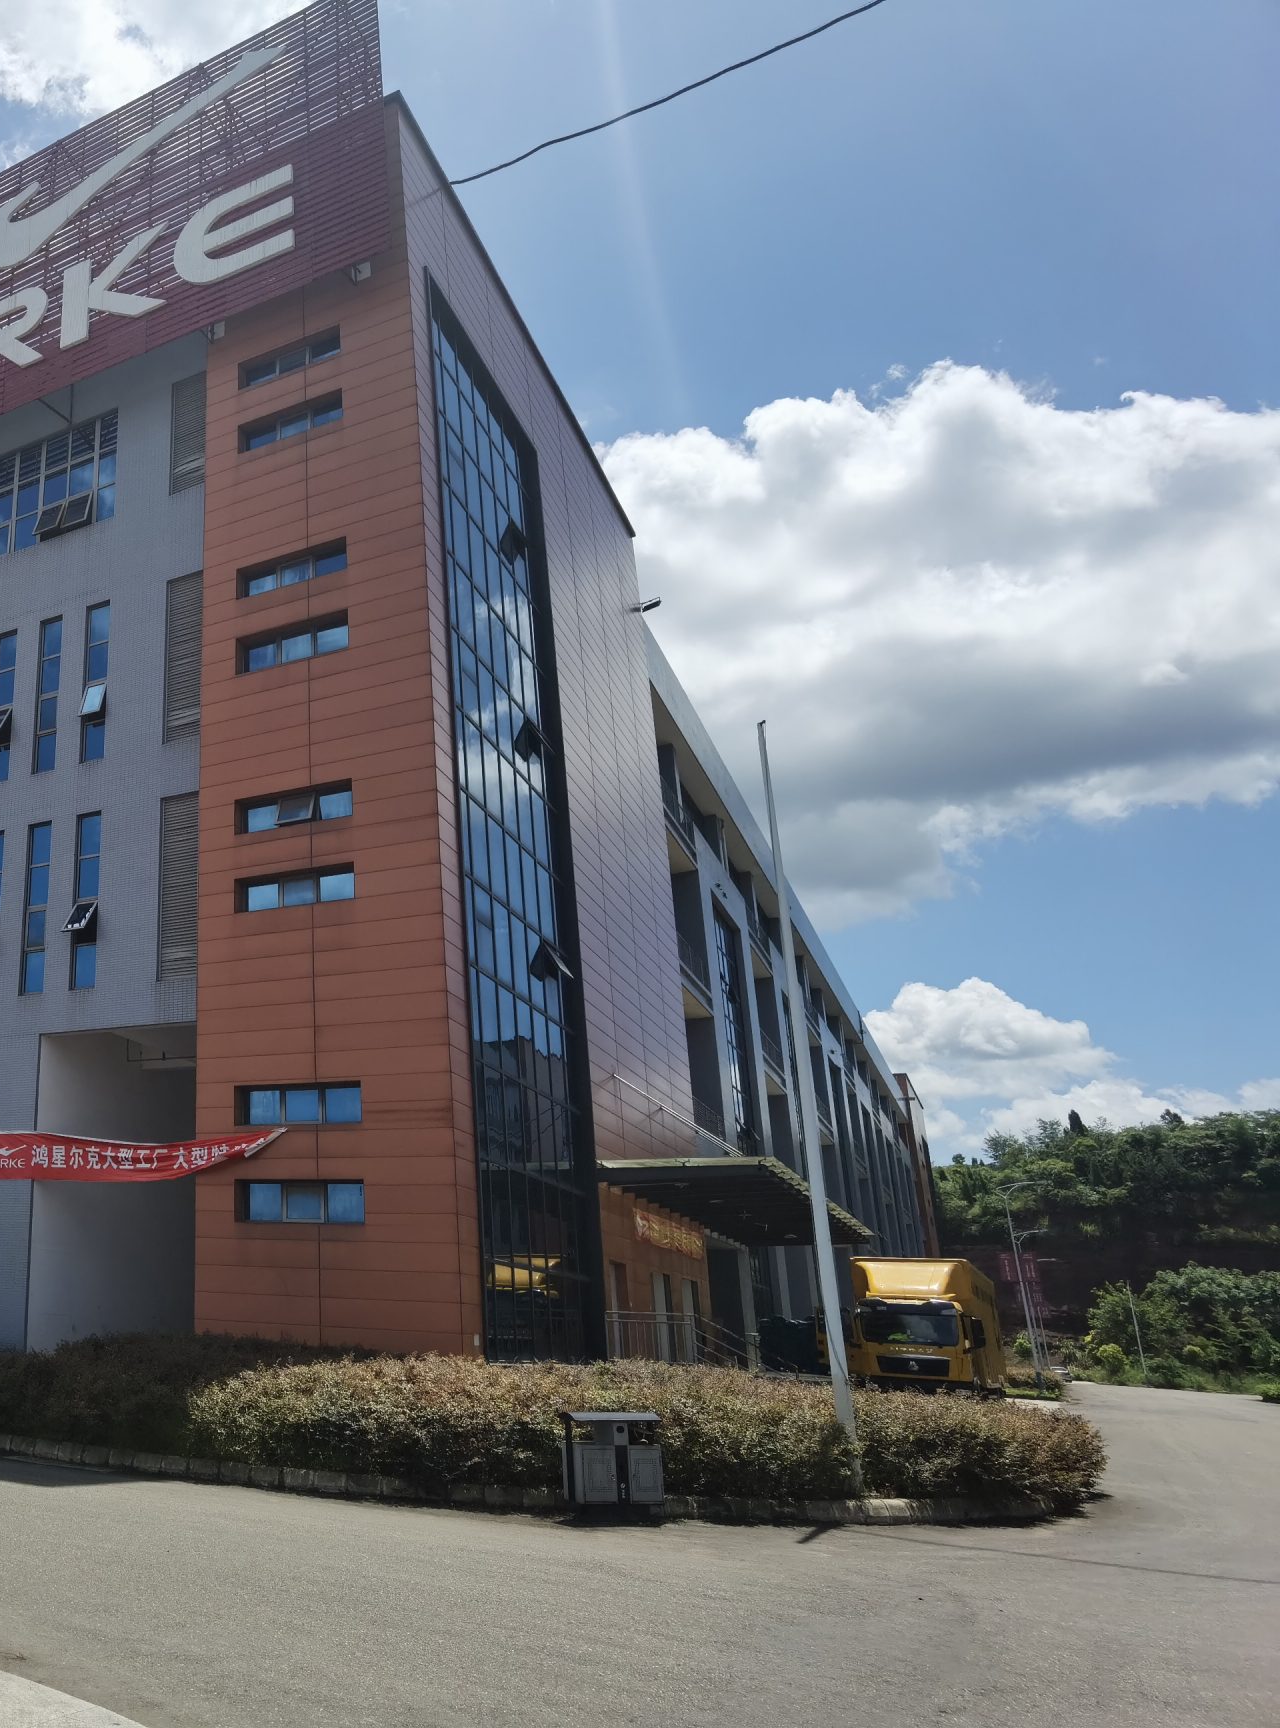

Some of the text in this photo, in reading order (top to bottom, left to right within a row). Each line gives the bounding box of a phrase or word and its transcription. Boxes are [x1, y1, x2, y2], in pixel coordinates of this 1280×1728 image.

[31, 1144, 168, 1170] 鸿星尔克大型工厂
